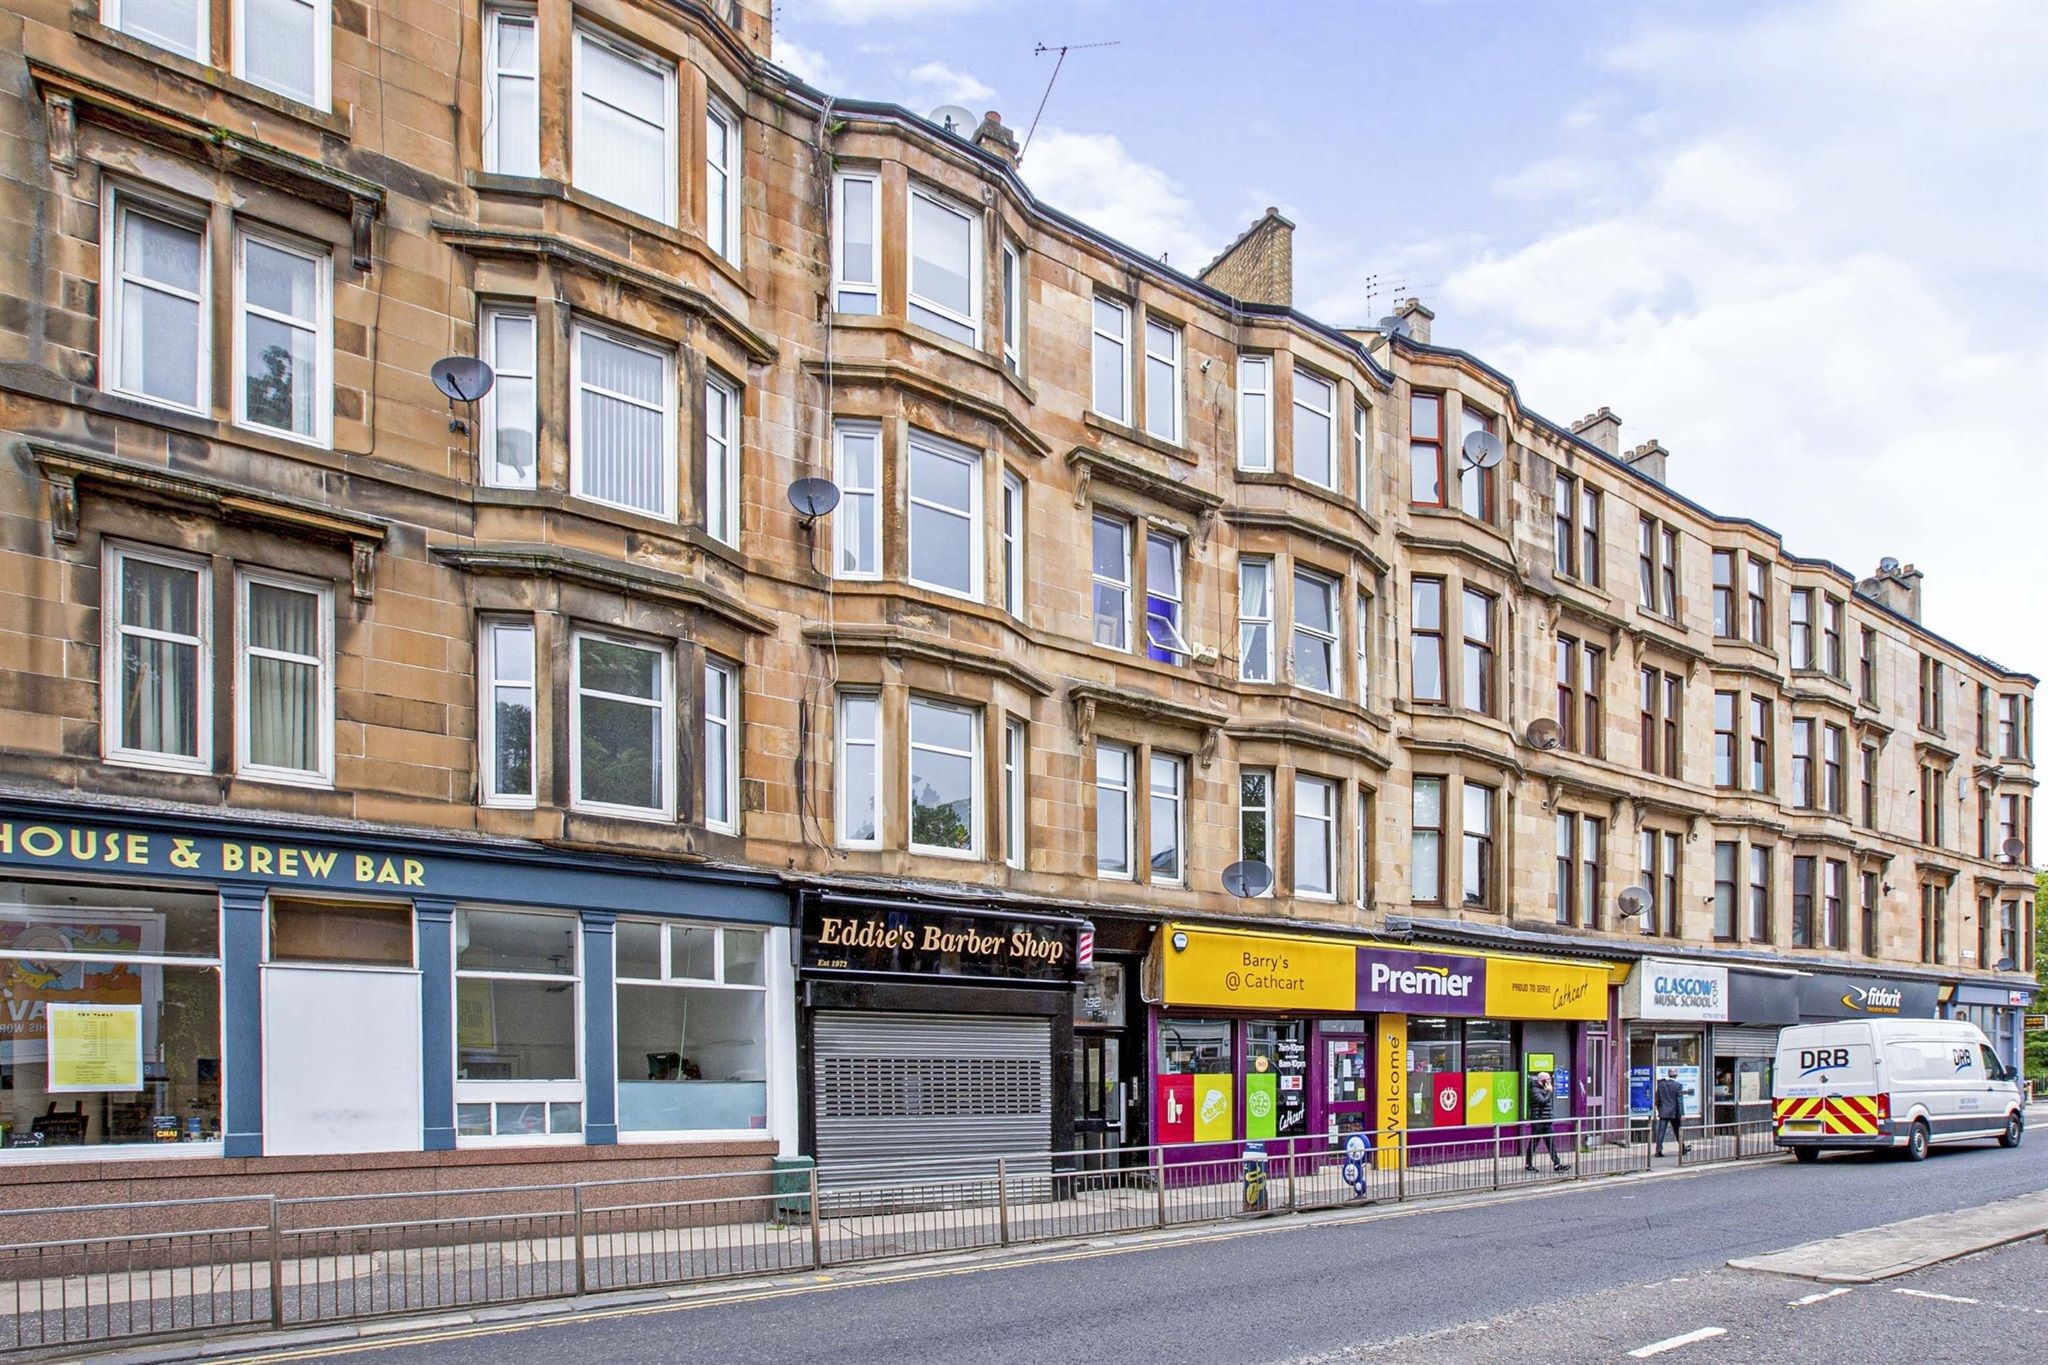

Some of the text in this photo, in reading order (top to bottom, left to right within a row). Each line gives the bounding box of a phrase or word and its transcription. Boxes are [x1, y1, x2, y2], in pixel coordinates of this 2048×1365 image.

[169, 837, 201, 869] &
[222, 843, 338, 879] BREW
[355, 854, 426, 887] BAR
[818, 917, 1064, 963] Eddie's Barber Shop
[817, 958, 848, 968] Est 1972
[1242, 951, 1289, 972] Barry's
[1225, 971, 1305, 991] @ Cathcart
[1371, 963, 1473, 997] Premier
[1512, 982, 1551, 994] PROUD TO SERVE
[1655, 976, 1712, 996] GLASGOW
[1552, 972, 1589, 1010] Cathcart
[1654, 994, 1712, 1008] MUSIC SCHOOL
[1867, 986, 1902, 1007] fitforit
[1800, 1048, 1850, 1069] DRB
[1952, 1048, 1972, 1066] DRB
[1387, 1036, 1400, 1140] Welcome
